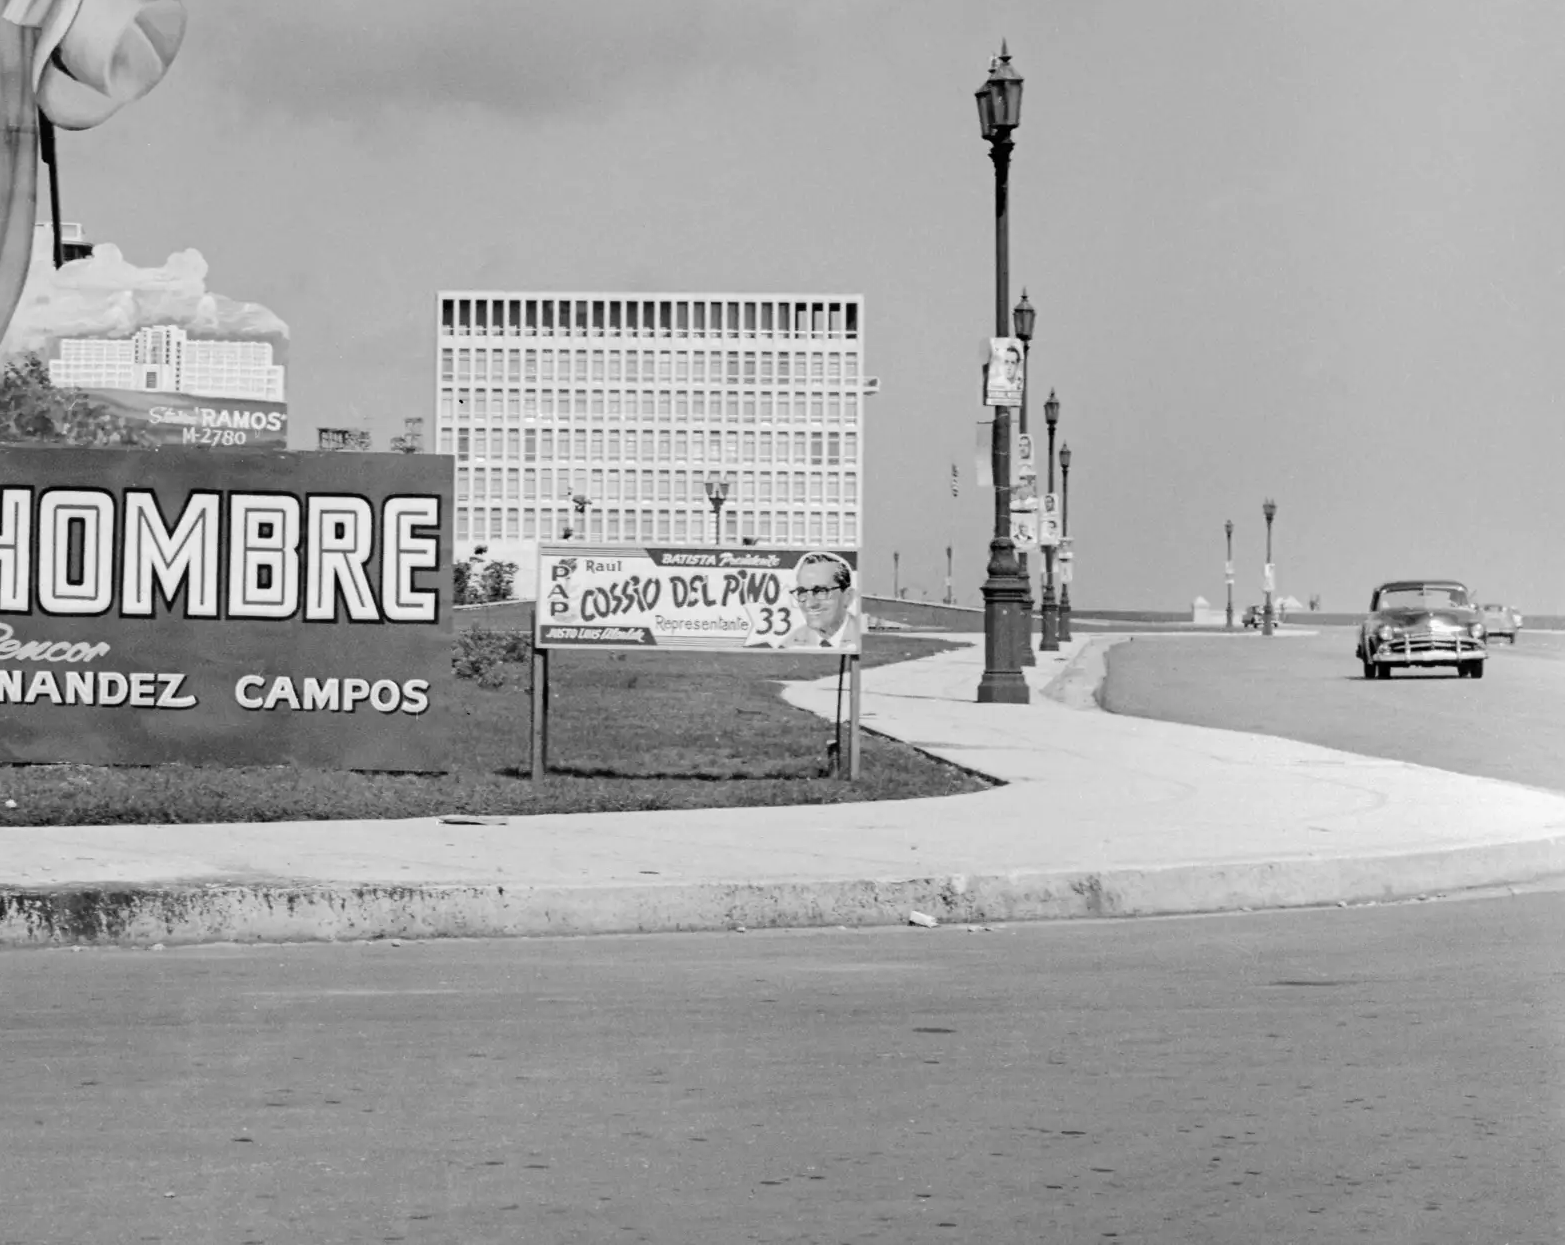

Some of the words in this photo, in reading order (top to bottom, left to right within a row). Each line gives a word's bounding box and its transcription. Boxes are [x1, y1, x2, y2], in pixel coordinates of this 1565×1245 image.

[183, 427, 246, 446] M-2780
[586, 559, 622, 572] Raul
[662, 552, 716, 566] BATISTA
[669, 575, 716, 608] DEL
[655, 614, 749, 633] Representante
[755, 607, 791, 636] 33
[235, 673, 431, 716] CAMPOS
